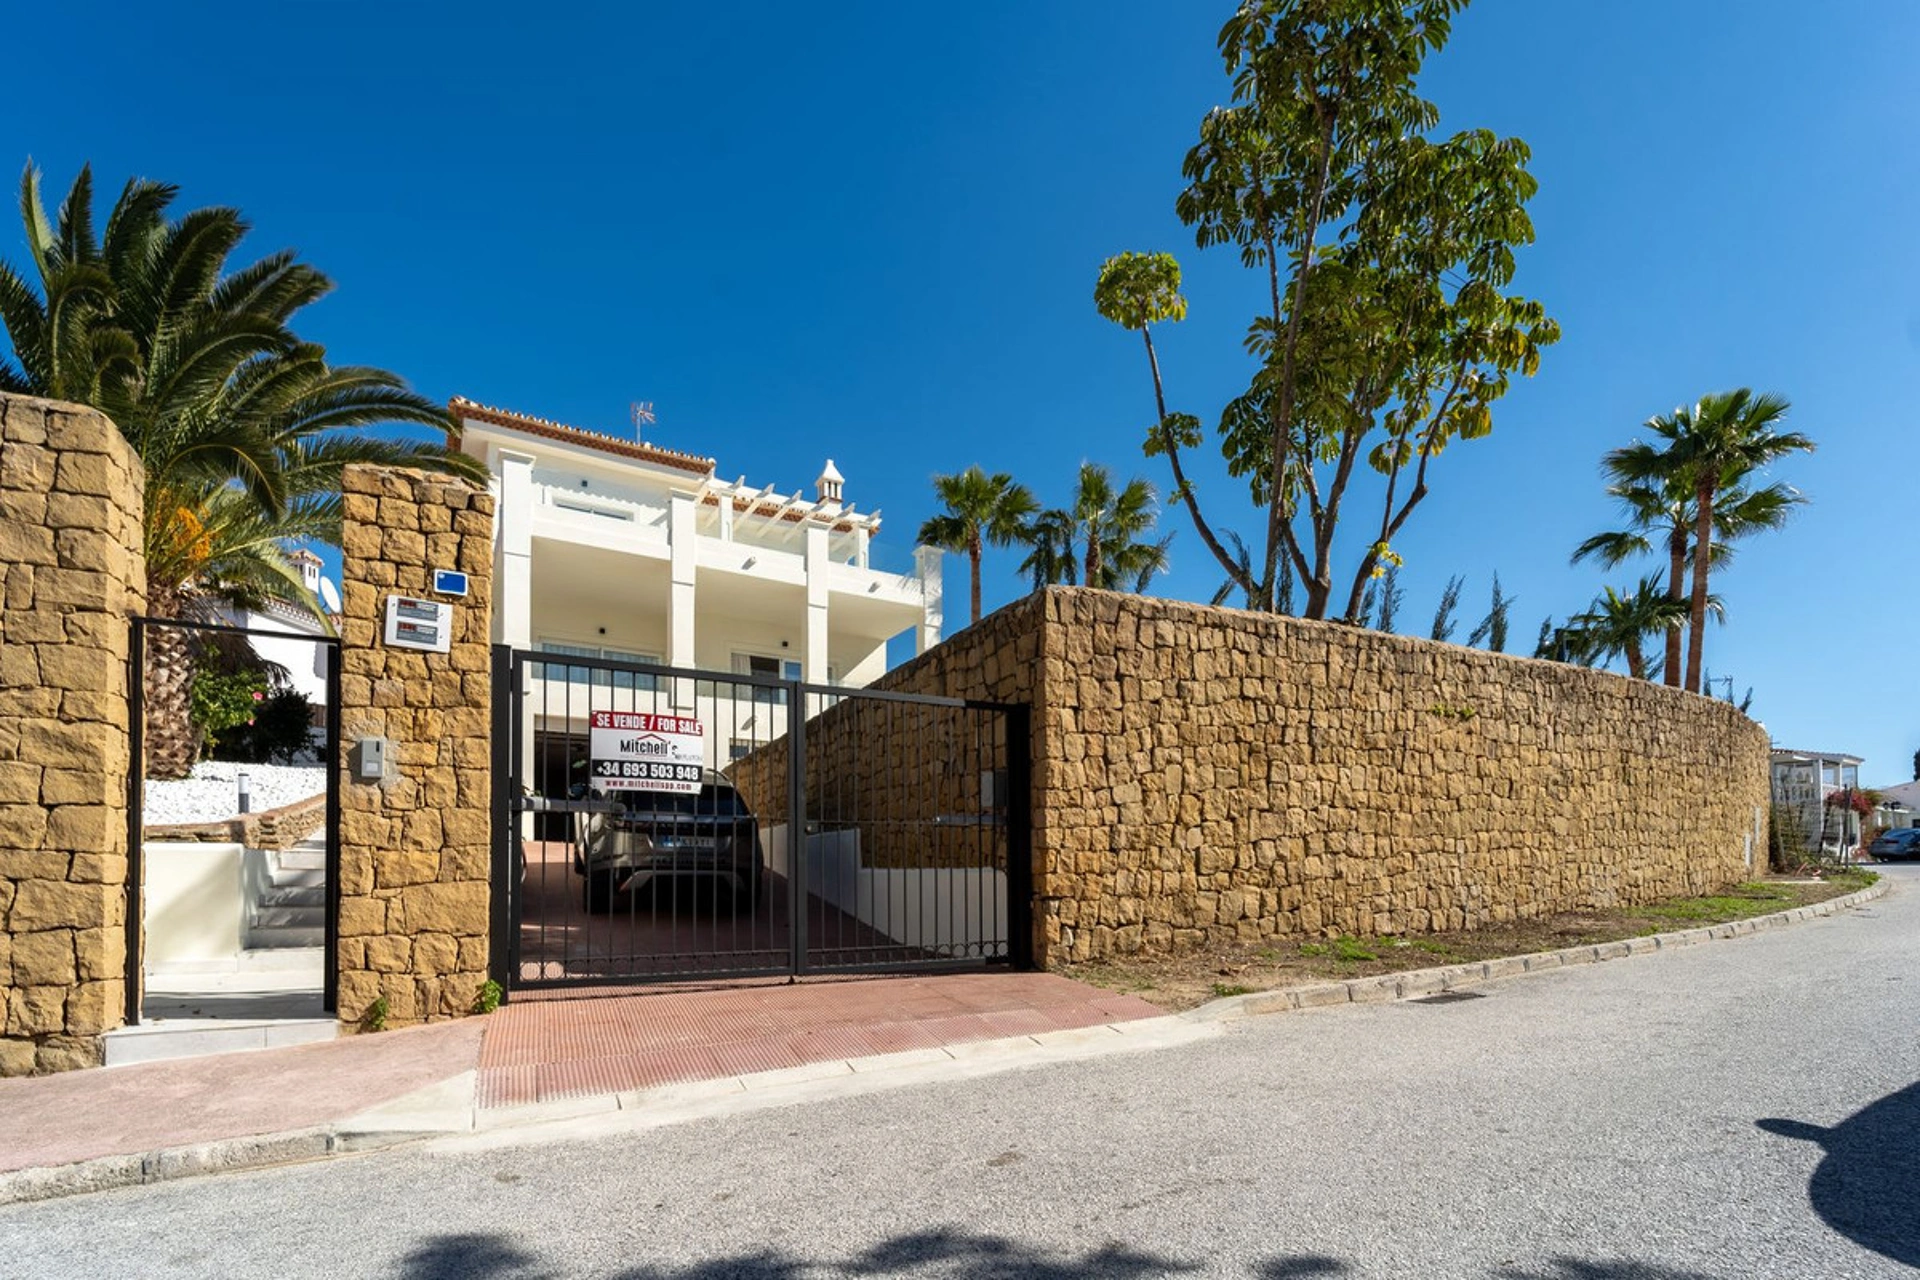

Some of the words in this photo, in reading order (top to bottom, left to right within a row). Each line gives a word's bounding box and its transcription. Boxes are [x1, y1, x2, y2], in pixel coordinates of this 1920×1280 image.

[596, 713, 611, 727] SE
[612, 714, 646, 729] VENDE
[649, 716, 655, 730] /
[657, 718, 677, 732] FOR
[678, 720, 702, 735] SALE
[597, 761, 620, 776] +34
[623, 762, 647, 777] 693
[650, 764, 674, 779] 503
[676, 766, 699, 780] 948
